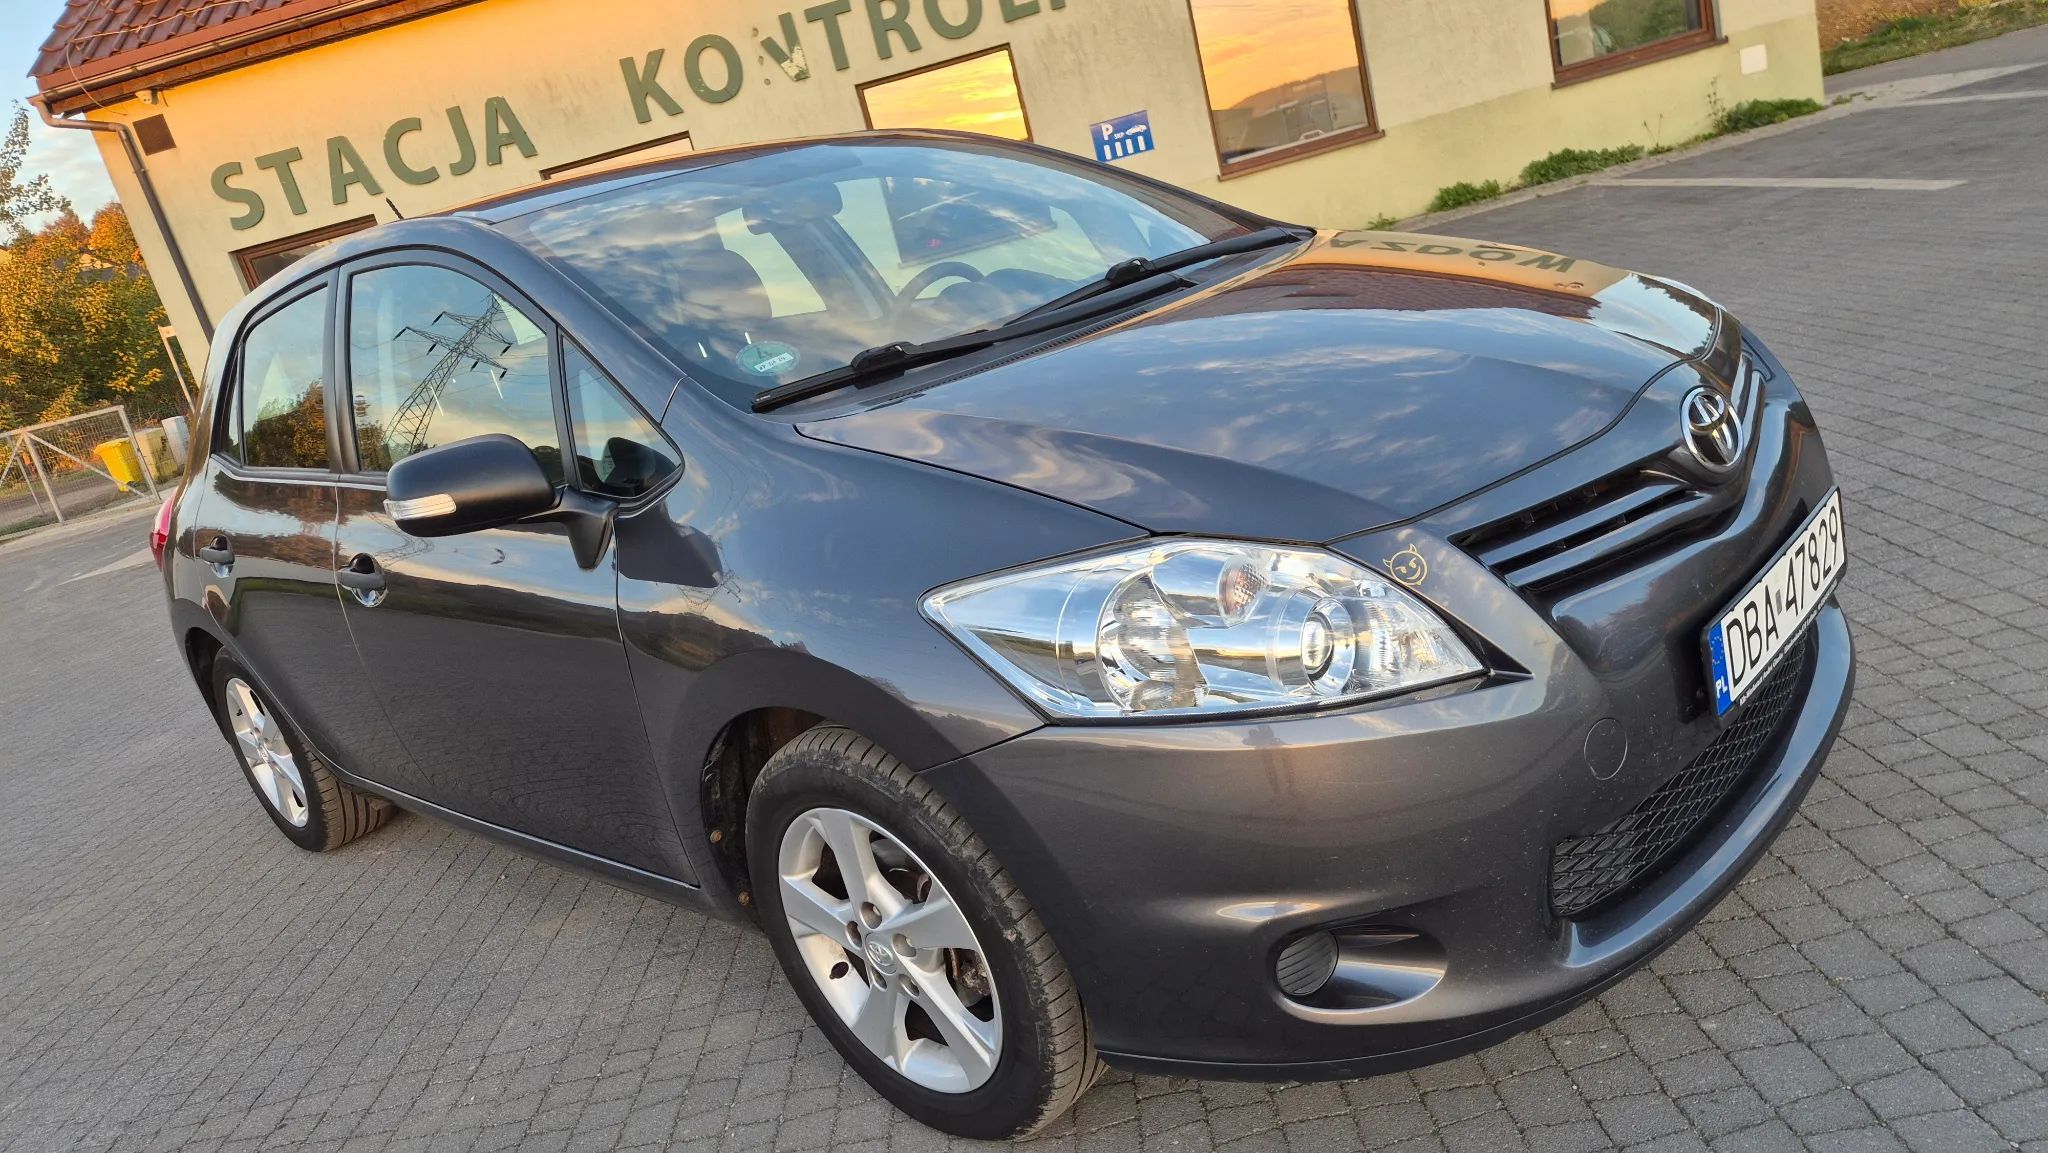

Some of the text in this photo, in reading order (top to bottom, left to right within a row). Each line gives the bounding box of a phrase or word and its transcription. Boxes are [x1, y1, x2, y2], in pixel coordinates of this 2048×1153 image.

[210, 0, 1066, 231] STACJA KONTRO
[1101, 123, 1113, 140] P
[1726, 585, 1779, 688] DBA
[1785, 505, 1838, 617] 47829
[1715, 675, 1728, 699] PL
